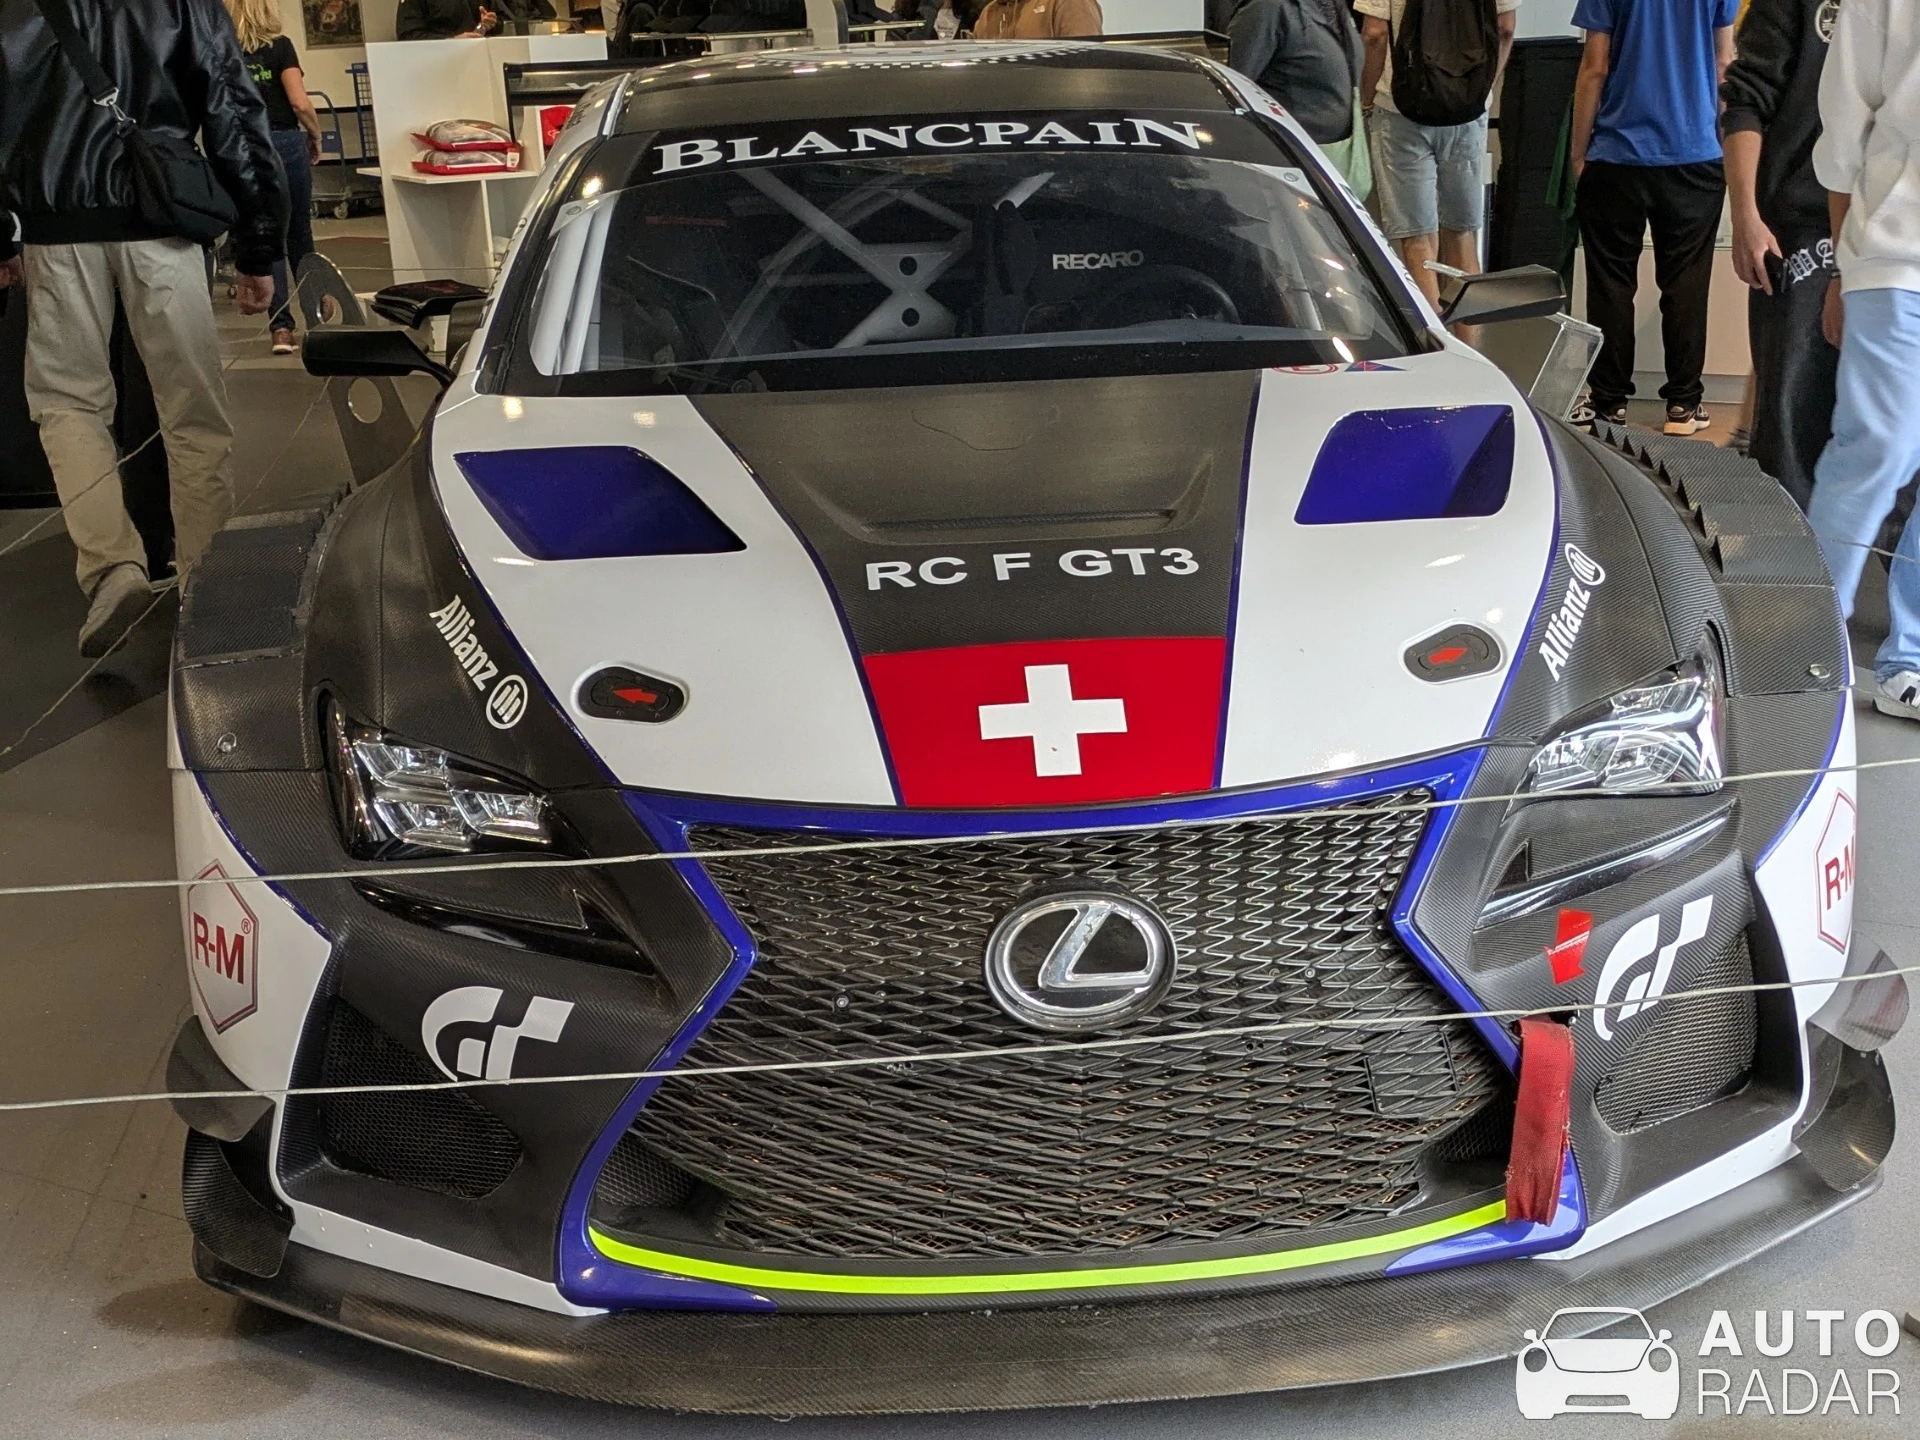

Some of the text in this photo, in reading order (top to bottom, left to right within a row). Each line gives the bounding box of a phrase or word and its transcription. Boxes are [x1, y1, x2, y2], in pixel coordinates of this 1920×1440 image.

[652, 118, 1201, 175] BLANCPAIN
[1052, 249, 1145, 270] RECARO
[865, 548, 1200, 590] RC F GT3
[428, 594, 499, 692] Allianz
[1538, 577, 1591, 682] Allianz
